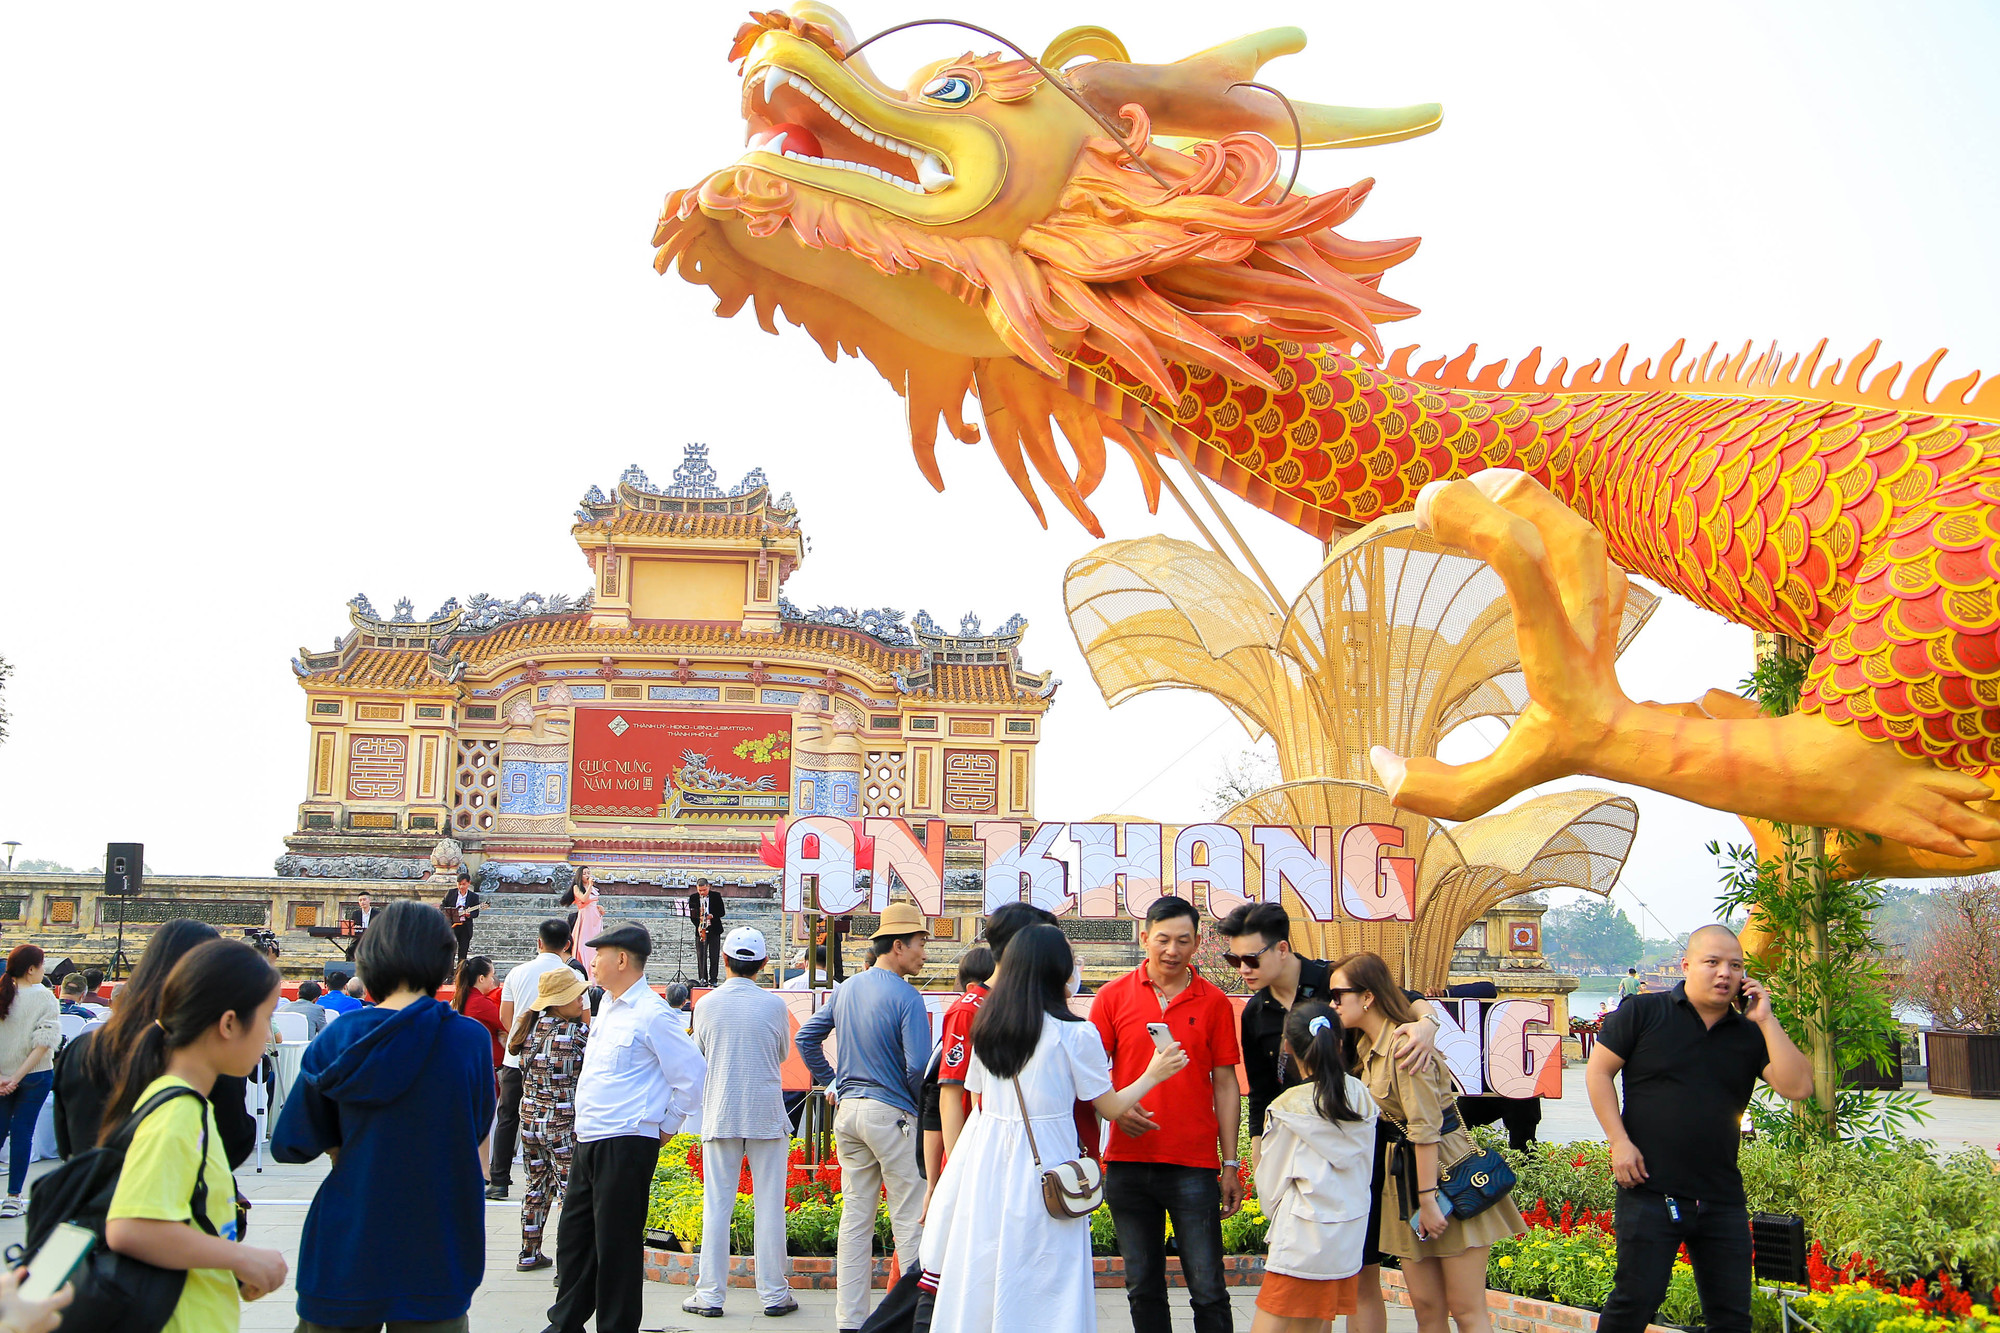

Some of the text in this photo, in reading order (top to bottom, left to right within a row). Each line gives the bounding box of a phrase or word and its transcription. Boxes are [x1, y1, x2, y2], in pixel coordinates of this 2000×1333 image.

[579, 758, 612, 776] CHÚC
[580, 776, 612, 792] NĂM
[782, 815, 1417, 922] AN KHANG
